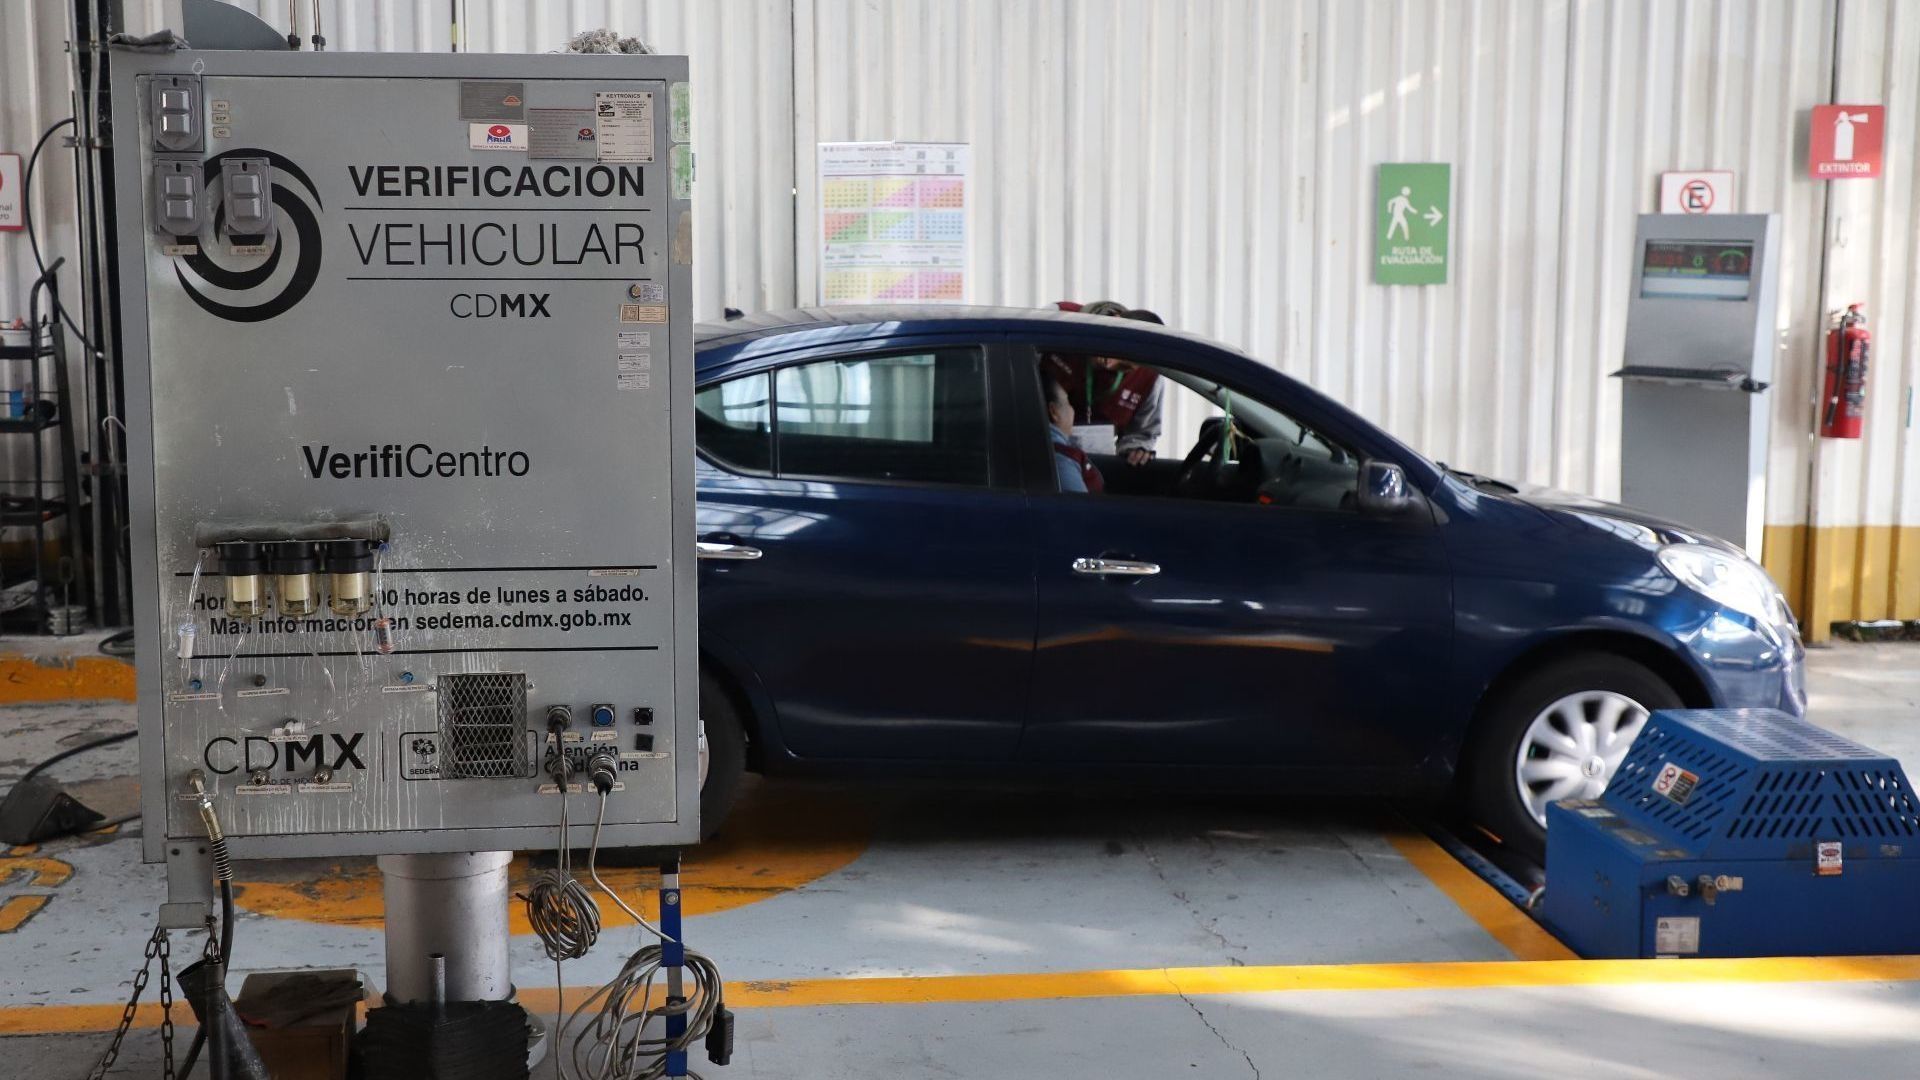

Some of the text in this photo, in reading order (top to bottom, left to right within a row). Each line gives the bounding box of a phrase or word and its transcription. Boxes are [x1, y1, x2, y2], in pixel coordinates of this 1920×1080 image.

[1818, 162, 1870, 174] EXTINTOR
[348, 222, 645, 266] VEHICULAR
[1392, 246, 1432, 255] RUTA DE
[450, 293, 552, 318] CDMX
[302, 443, 530, 479] VerifiCentro
[405, 587, 461, 606] horas
[467, 586, 491, 604] de
[498, 586, 551, 604] lunes
[556, 588, 568, 603] a
[573, 584, 649, 603] sábado.
[416, 609, 632, 632] sedema.cdmx.gob.mx
[203, 732, 367, 775] CDMX
